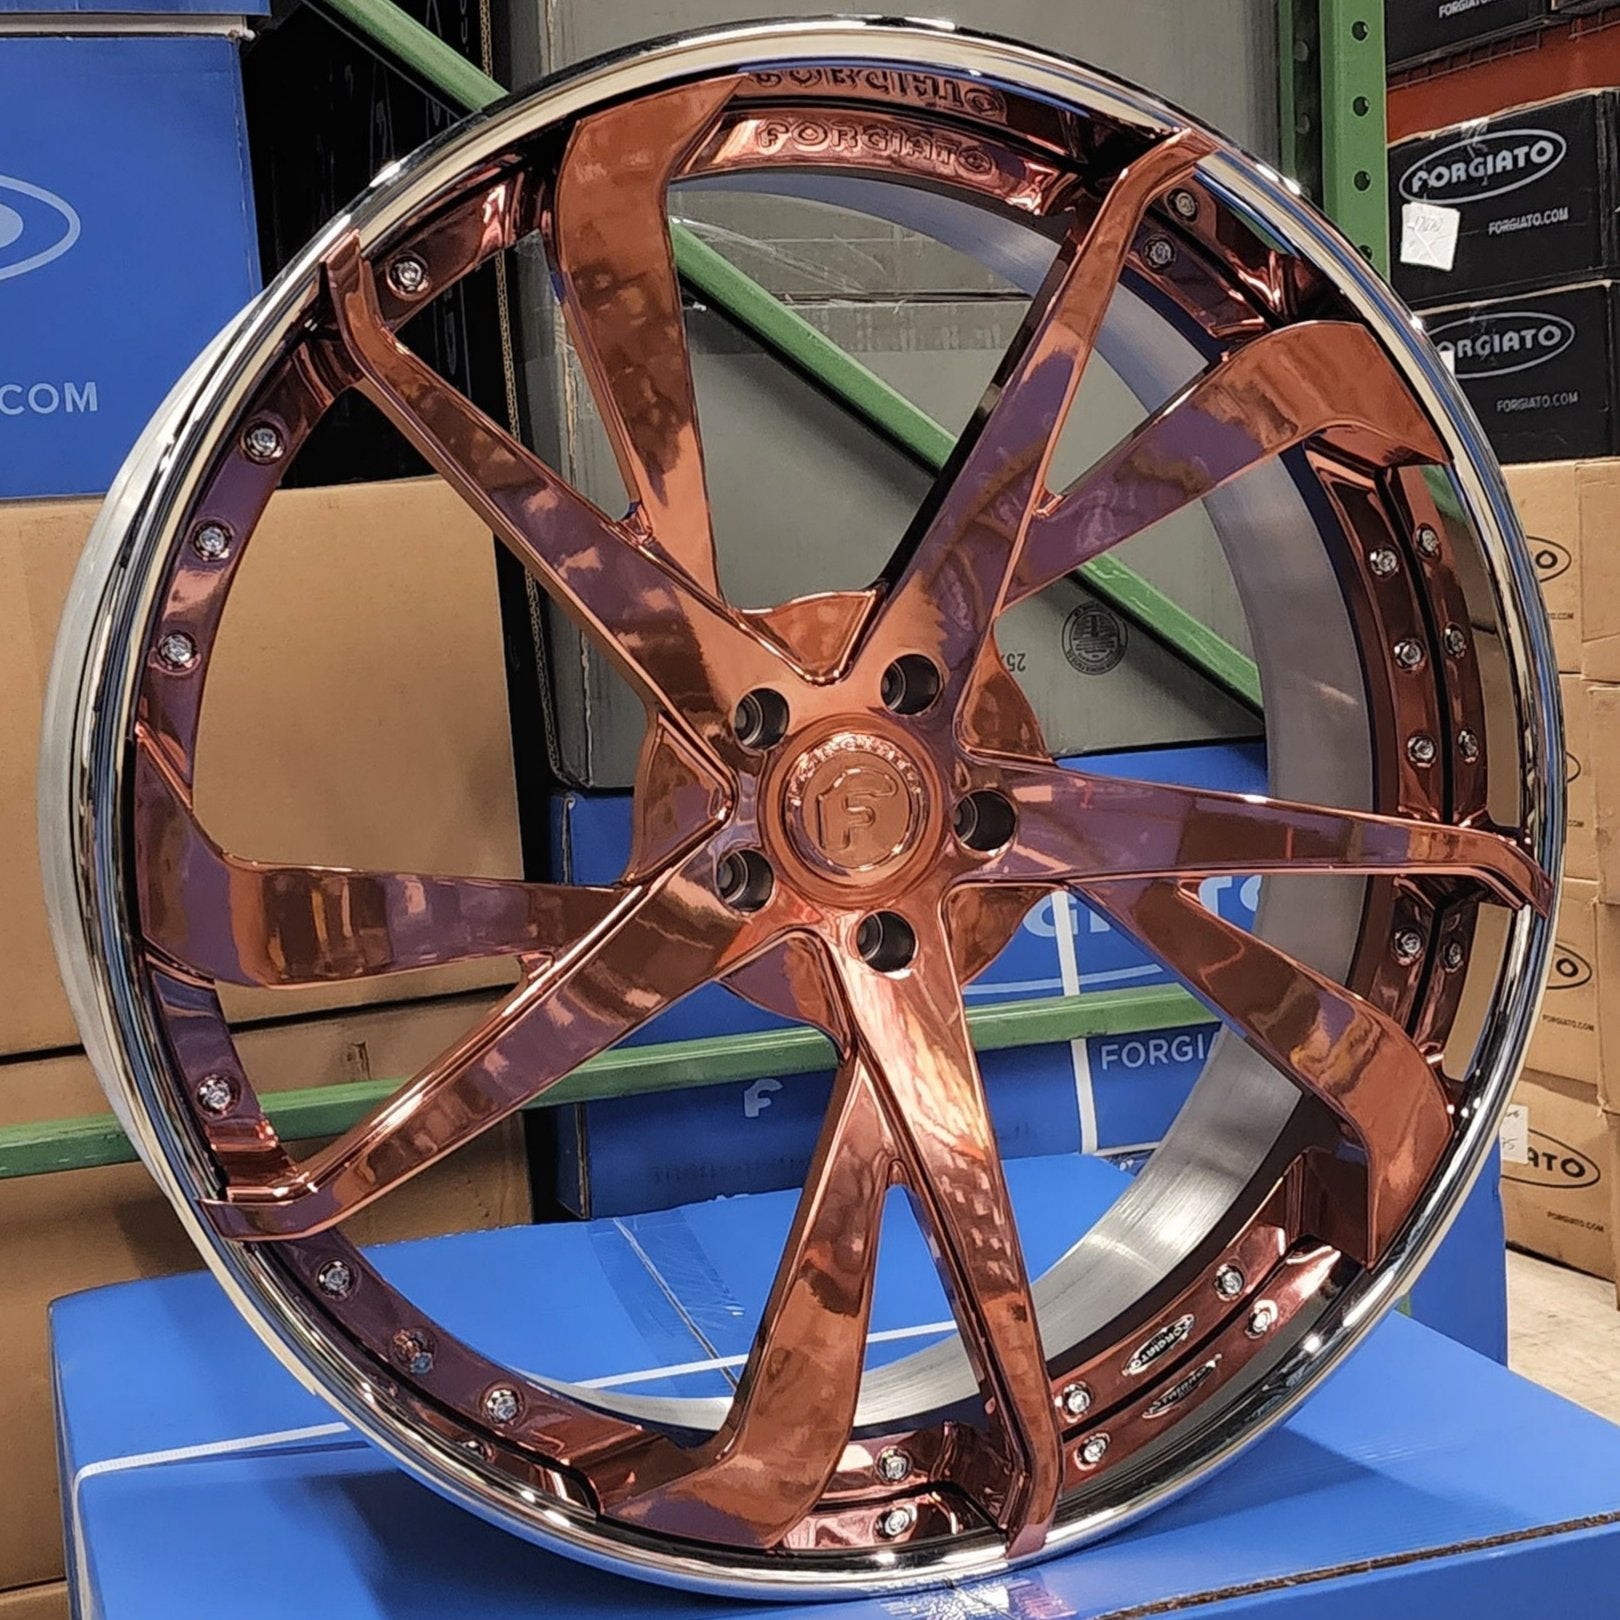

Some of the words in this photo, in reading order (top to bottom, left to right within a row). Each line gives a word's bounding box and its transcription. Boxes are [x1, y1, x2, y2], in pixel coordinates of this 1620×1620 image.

[756, 119, 998, 175] FORGIATO
[1412, 140, 1555, 194] FORGIATO
[1488, 207, 1570, 236] FORGIATO.COM
[1496, 392, 1579, 413] FORGIATO.COM
[1001, 653, 1026, 672] 25
[1101, 1032, 1214, 1070] FORGI
[743, 1078, 784, 1118] F
